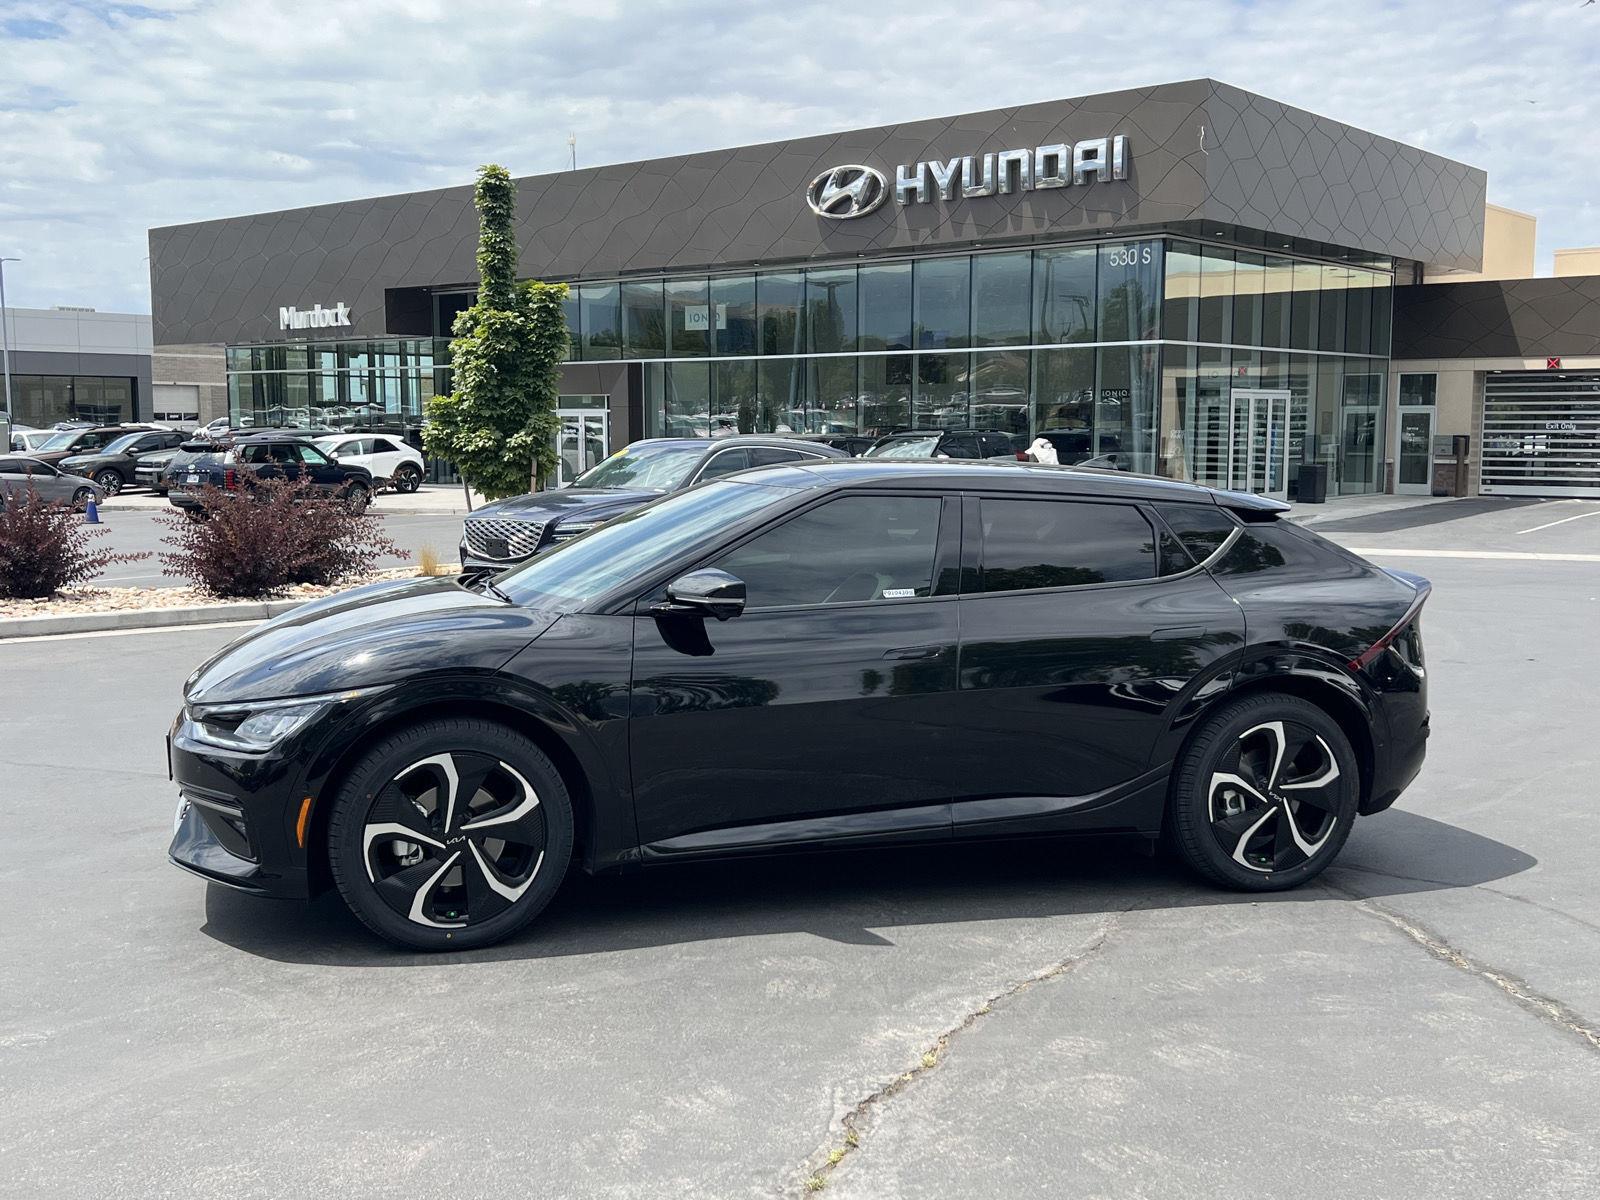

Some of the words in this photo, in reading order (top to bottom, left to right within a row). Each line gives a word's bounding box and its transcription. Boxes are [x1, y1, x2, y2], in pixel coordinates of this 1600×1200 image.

[896, 134, 1128, 205] HYUNDAI
[1109, 248, 1138, 267] 530
[1141, 247, 1151, 264] S
[279, 301, 352, 330] Murdock
[1102, 389, 1128, 397] IONIQ
[1545, 421, 1560, 430] Exit
[1560, 421, 1577, 431] Only
